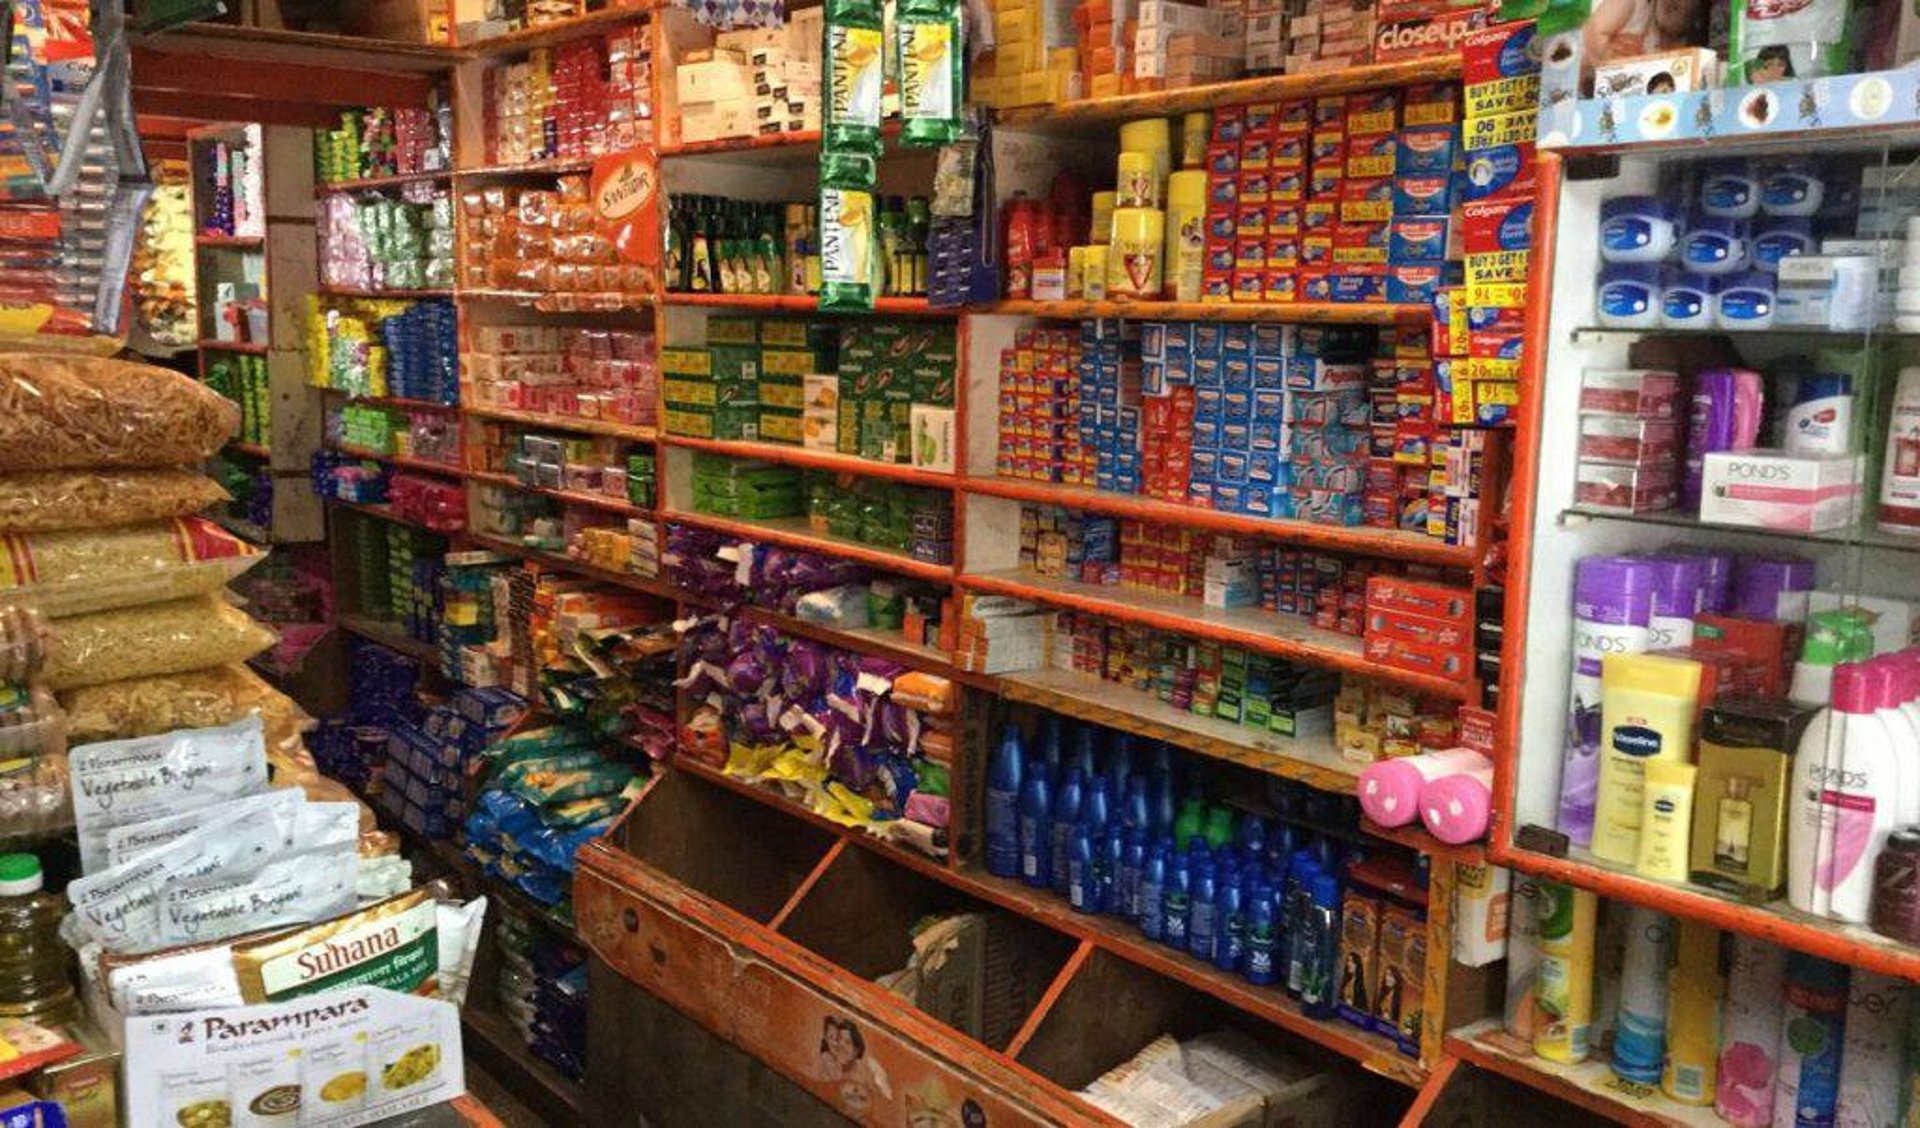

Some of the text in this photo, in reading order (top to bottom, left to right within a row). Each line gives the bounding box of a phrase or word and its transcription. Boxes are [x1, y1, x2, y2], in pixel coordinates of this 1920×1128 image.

[1475, 95, 1515, 111] SAVE
[823, 193, 839, 271] PANTENE
[1475, 268, 1514, 280] SAVE
[168, 900, 246, 934] Vegetable
[297, 926, 400, 980] Suhana
[204, 995, 370, 1040] Parampara
